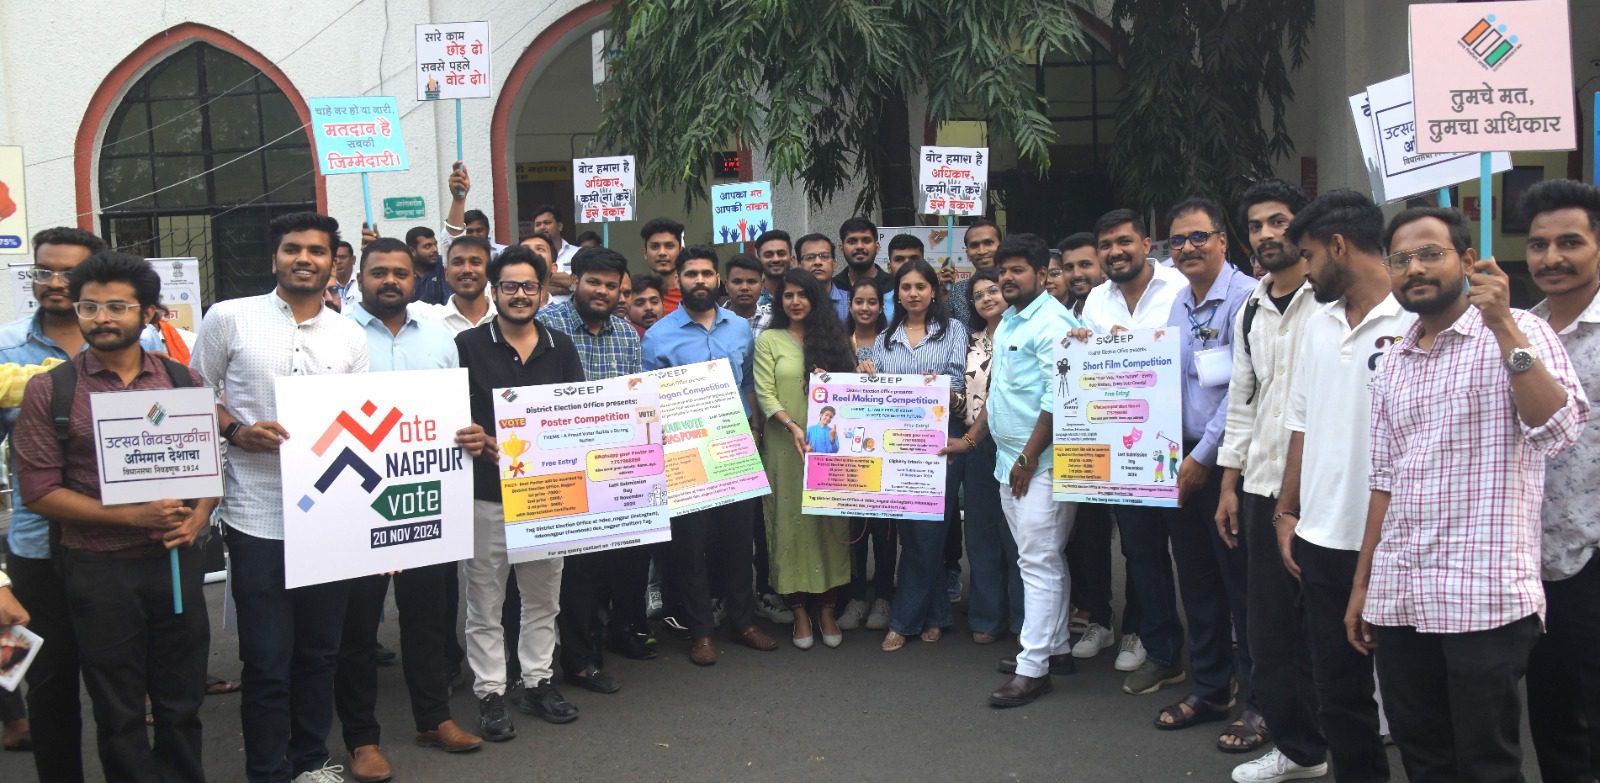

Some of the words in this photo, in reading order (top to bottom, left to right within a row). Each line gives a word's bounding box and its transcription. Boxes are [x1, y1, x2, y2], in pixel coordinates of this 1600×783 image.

[425, 28, 442, 42] सारे
[446, 32, 464, 40] काम
[446, 41, 466, 58] छोड़
[471, 40, 483, 55] दो
[420, 58, 445, 72] सबसे
[449, 57, 470, 72] पहले
[446, 71, 465, 86] वोट
[1450, 82, 1494, 112] तुमचे
[1498, 88, 1534, 106] मत,
[315, 104, 332, 116] चाहे
[334, 107, 347, 116] नर
[350, 104, 359, 116] हो
[361, 106, 370, 114] या
[324, 122, 376, 136] मतदान
[376, 117, 391, 136] है
[1428, 119, 1478, 142] तुमचा
[1484, 110, 1561, 135] अधिकार
[346, 137, 375, 148] सबकी
[926, 150, 942, 162] वोट
[946, 154, 972, 165] हमारा
[976, 151, 983, 166] है
[578, 162, 593, 174] वोट
[596, 164, 620, 174] हमारा
[623, 160, 630, 172] है
[932, 166, 974, 180] अधिकार,
[720, 190, 747, 200] आपका
[750, 190, 762, 198] मत
[926, 182, 946, 194] कभी
[950, 186, 961, 194] ना
[965, 182, 980, 194] करें
[580, 191, 599, 202] कभी
[602, 193, 612, 202] ना
[930, 197, 946, 210] इसे
[949, 197, 974, 210] बेकार
[586, 206, 599, 218] इसे
[602, 204, 626, 216] बेकार
[715, 202, 742, 214] आपकी
[745, 202, 768, 210] ताकत
[1083, 360, 1104, 370] Short
[1105, 359, 1120, 369] Film
[1122, 356, 1172, 370] Competition
[648, 369, 688, 380] WEEP
[554, 386, 604, 397] SWEEP
[659, 390, 682, 400] logan
[682, 382, 730, 396] Competition
[526, 406, 552, 414] District
[554, 404, 582, 412] Election
[584, 401, 604, 410] Office
[606, 398, 638, 408] presents:
[852, 394, 884, 404] Making
[886, 395, 938, 406] Competition
[499, 418, 526, 428] VOTE
[541, 418, 572, 428] Poster
[573, 412, 630, 426] Competition
[663, 420, 682, 433] OUR
[683, 417, 706, 429] VOTE
[142, 428, 210, 448] निवडणुकीचा
[126, 450, 165, 464] अभिमान
[168, 446, 200, 462] देशाचा
[558, 458, 578, 466] Entry!
[386, 447, 463, 478] NAGPUR
[388, 486, 438, 516] vote
[556, 522, 576, 530] Election
[372, 531, 386, 546] 20
[390, 528, 410, 543] NOV
[414, 524, 440, 540] 2024
